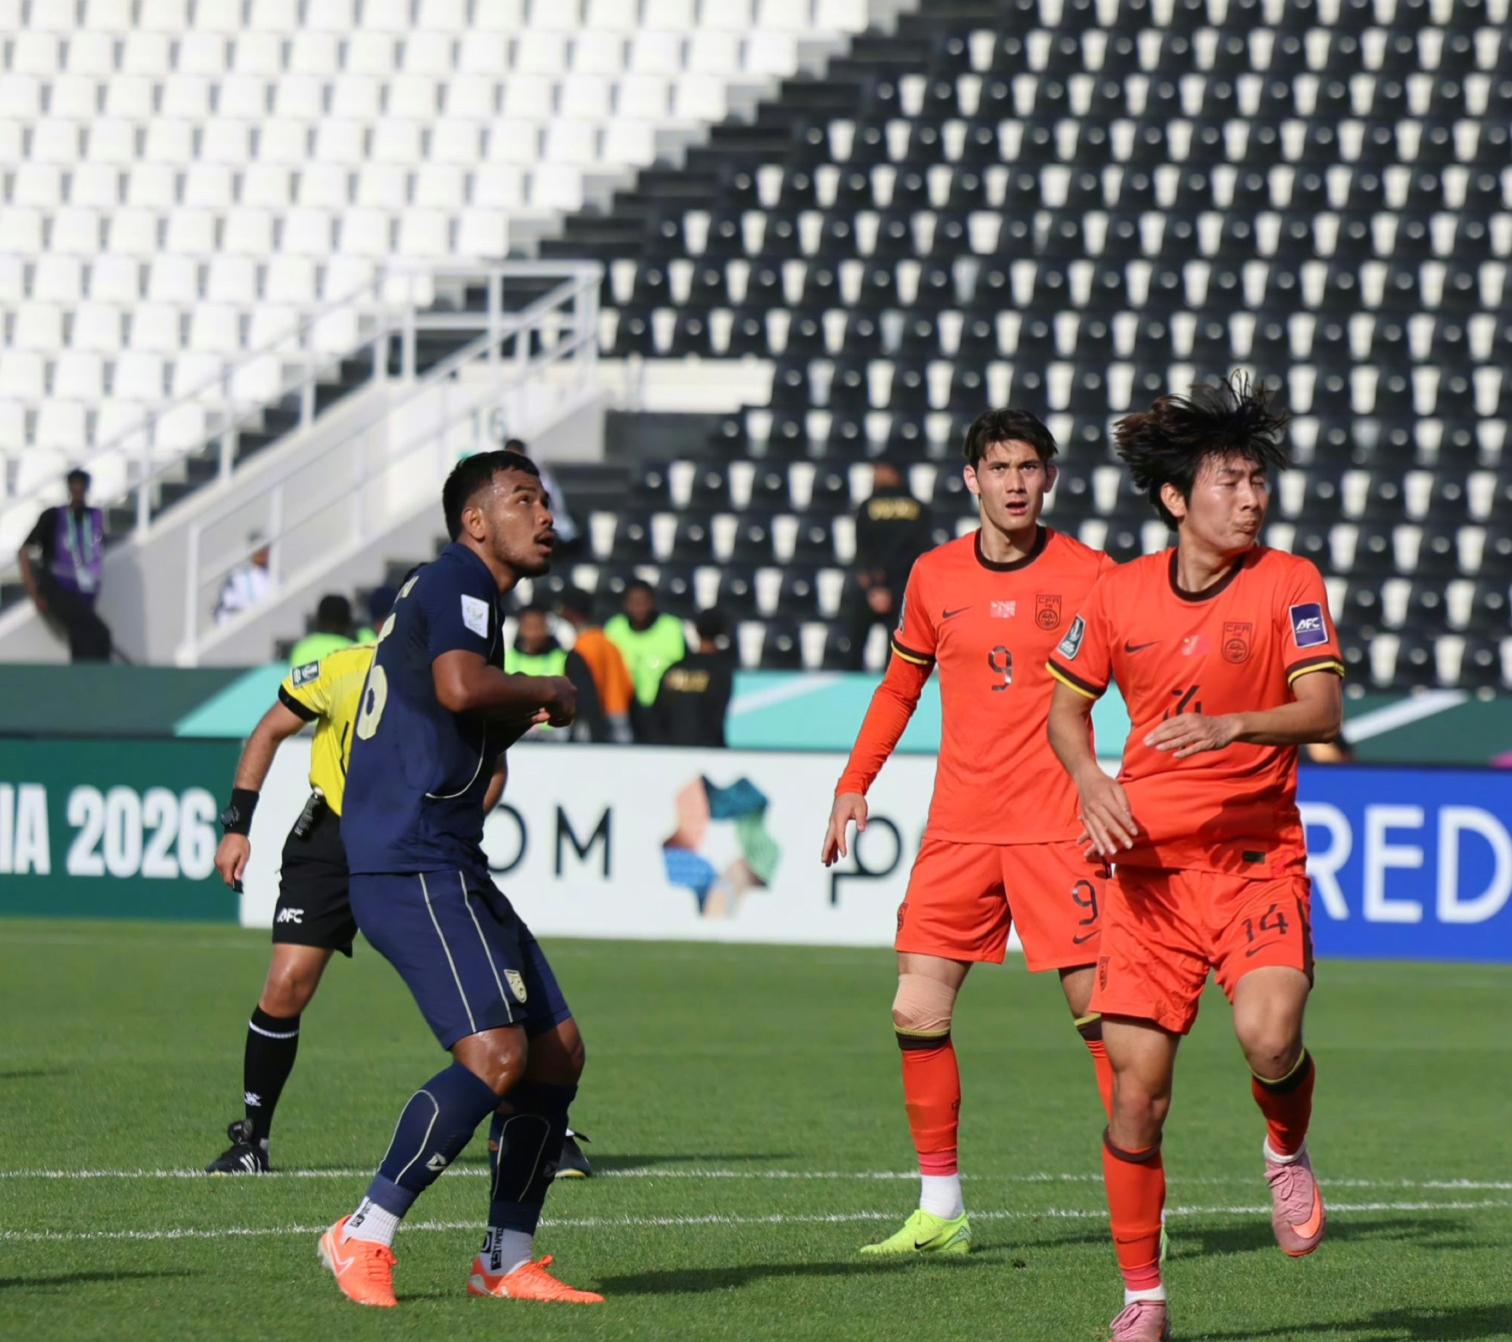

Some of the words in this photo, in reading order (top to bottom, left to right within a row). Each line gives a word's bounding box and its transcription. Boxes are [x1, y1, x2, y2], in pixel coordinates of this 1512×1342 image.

[1296, 616, 1320, 631] AFC
[988, 646, 1013, 692] 9
[66, 784, 219, 881] 2026
[276, 908, 305, 924] AFC
[1072, 879, 1099, 926] 9
[1242, 903, 1288, 943] 14
